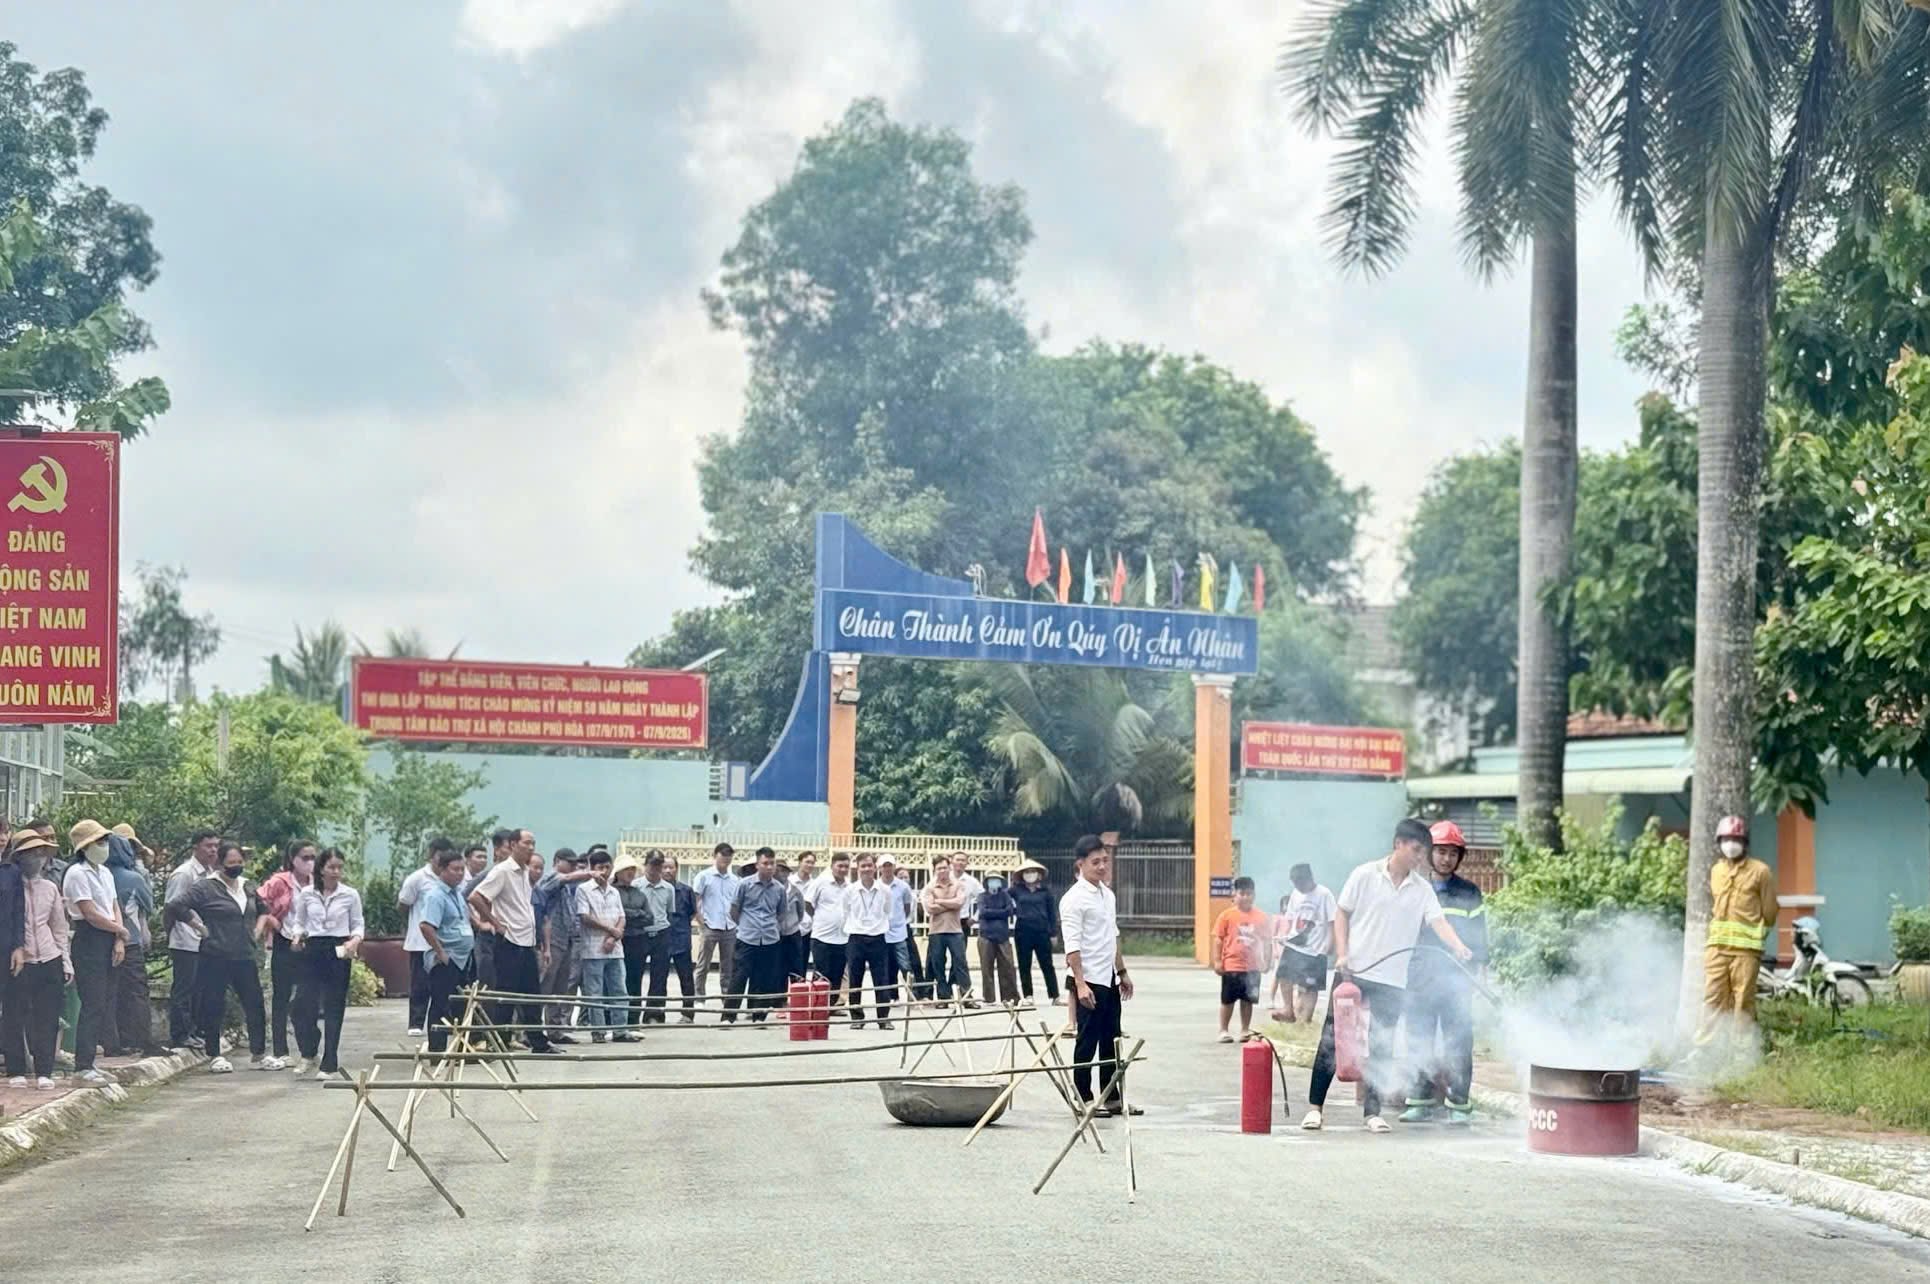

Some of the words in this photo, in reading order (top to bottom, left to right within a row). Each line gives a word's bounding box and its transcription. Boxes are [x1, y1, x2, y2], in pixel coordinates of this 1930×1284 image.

[8, 524, 66, 552] ĐẢNG
[0, 563, 41, 595] ỘNG
[49, 563, 89, 592] SẢN
[0, 602, 32, 634] IỆT
[39, 607, 87, 630] NAM
[839, 606, 896, 640] Chân
[902, 609, 975, 645] Thành
[979, 614, 1026, 647] Cảm
[1032, 616, 1063, 650] Ơn
[1113, 623, 1143, 660] Vị
[1146, 617, 1182, 656] Ân
[1187, 627, 1245, 660] Nhân
[0, 645, 42, 668] ANG
[50, 646, 101, 668] VINH
[0, 679, 40, 706] UÔN
[47, 680, 95, 706] NĂM
